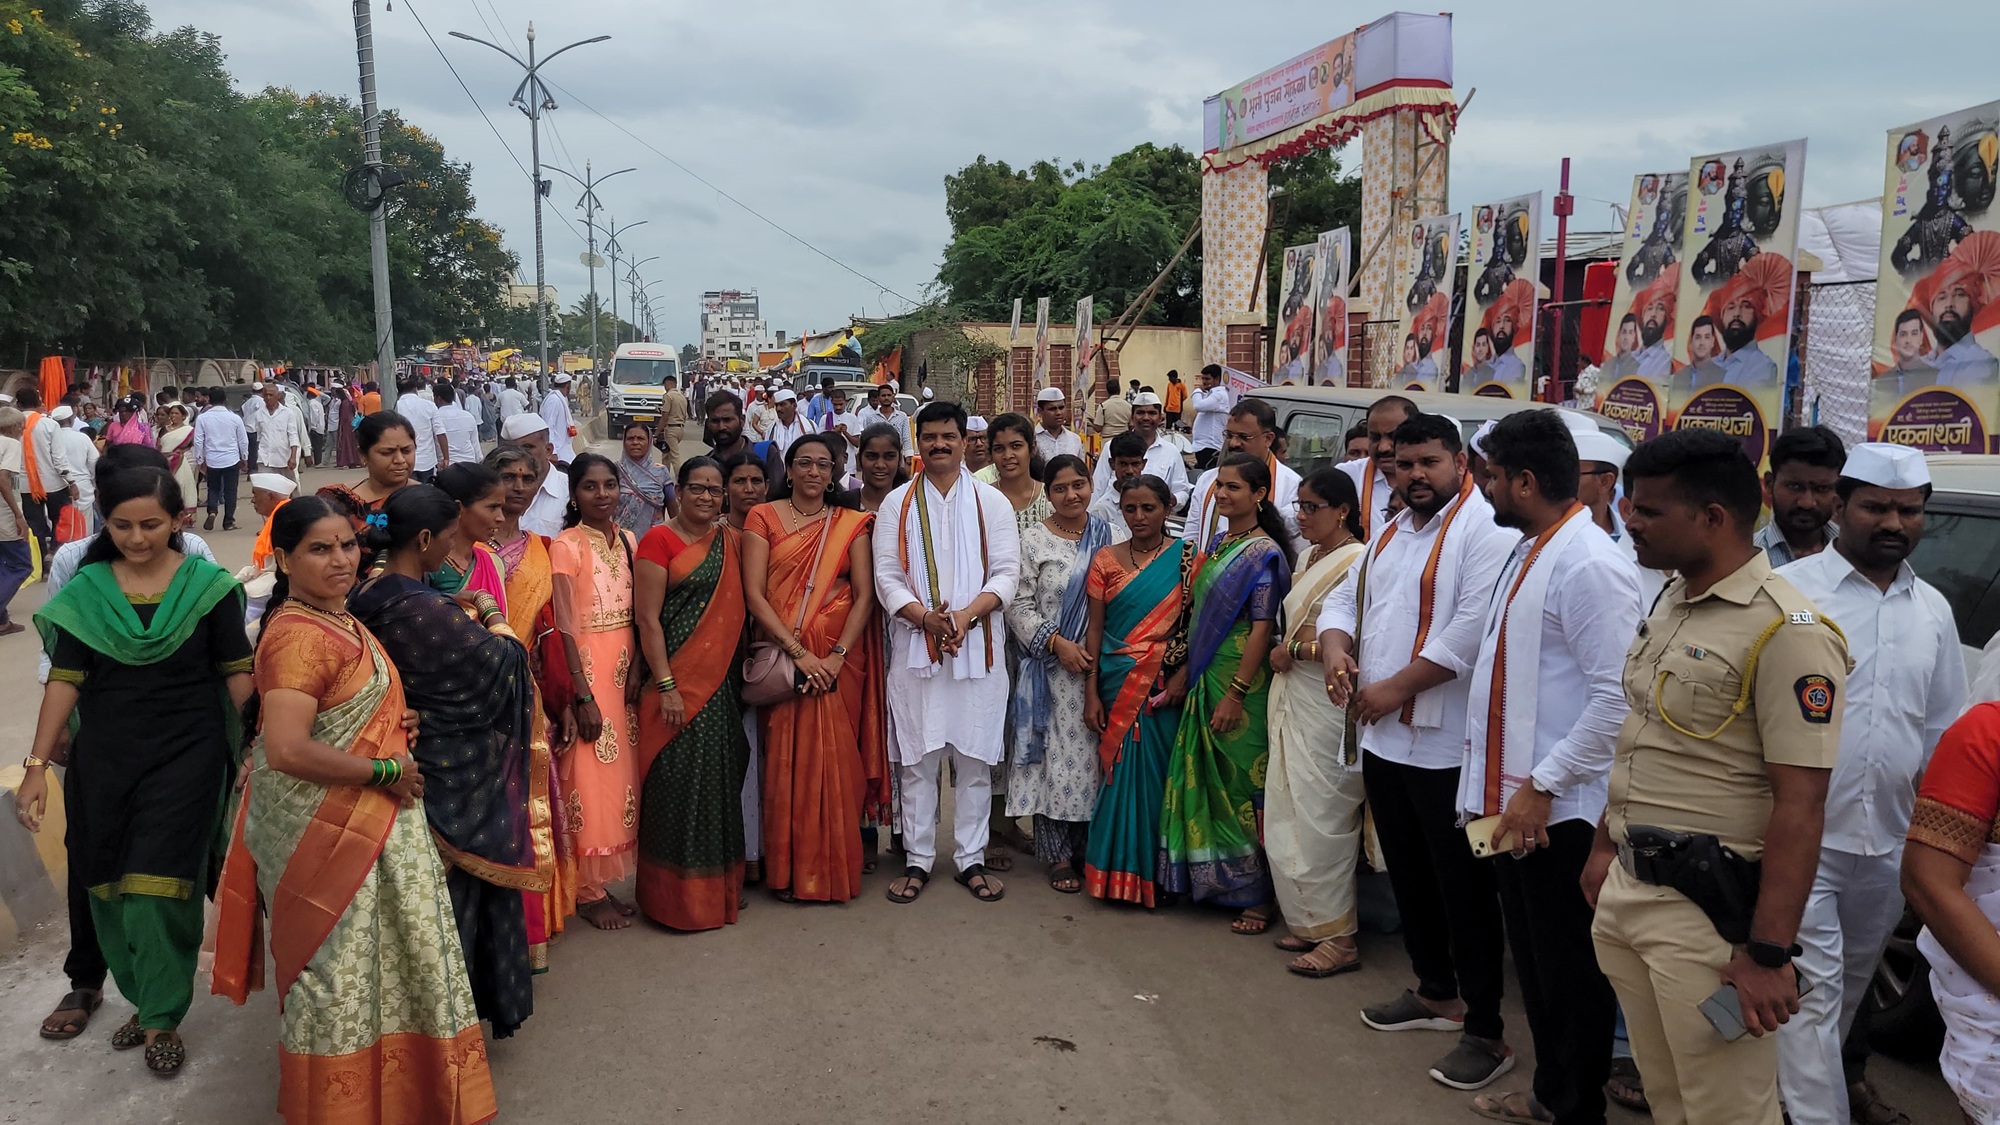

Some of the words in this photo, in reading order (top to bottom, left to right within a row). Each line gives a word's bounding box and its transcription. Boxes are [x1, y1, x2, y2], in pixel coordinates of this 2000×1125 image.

[1604, 401, 1654, 424] एकनाथजी
[1680, 411, 1754, 437] एकनाथजी
[1886, 416, 1972, 445] एकनाथजी
